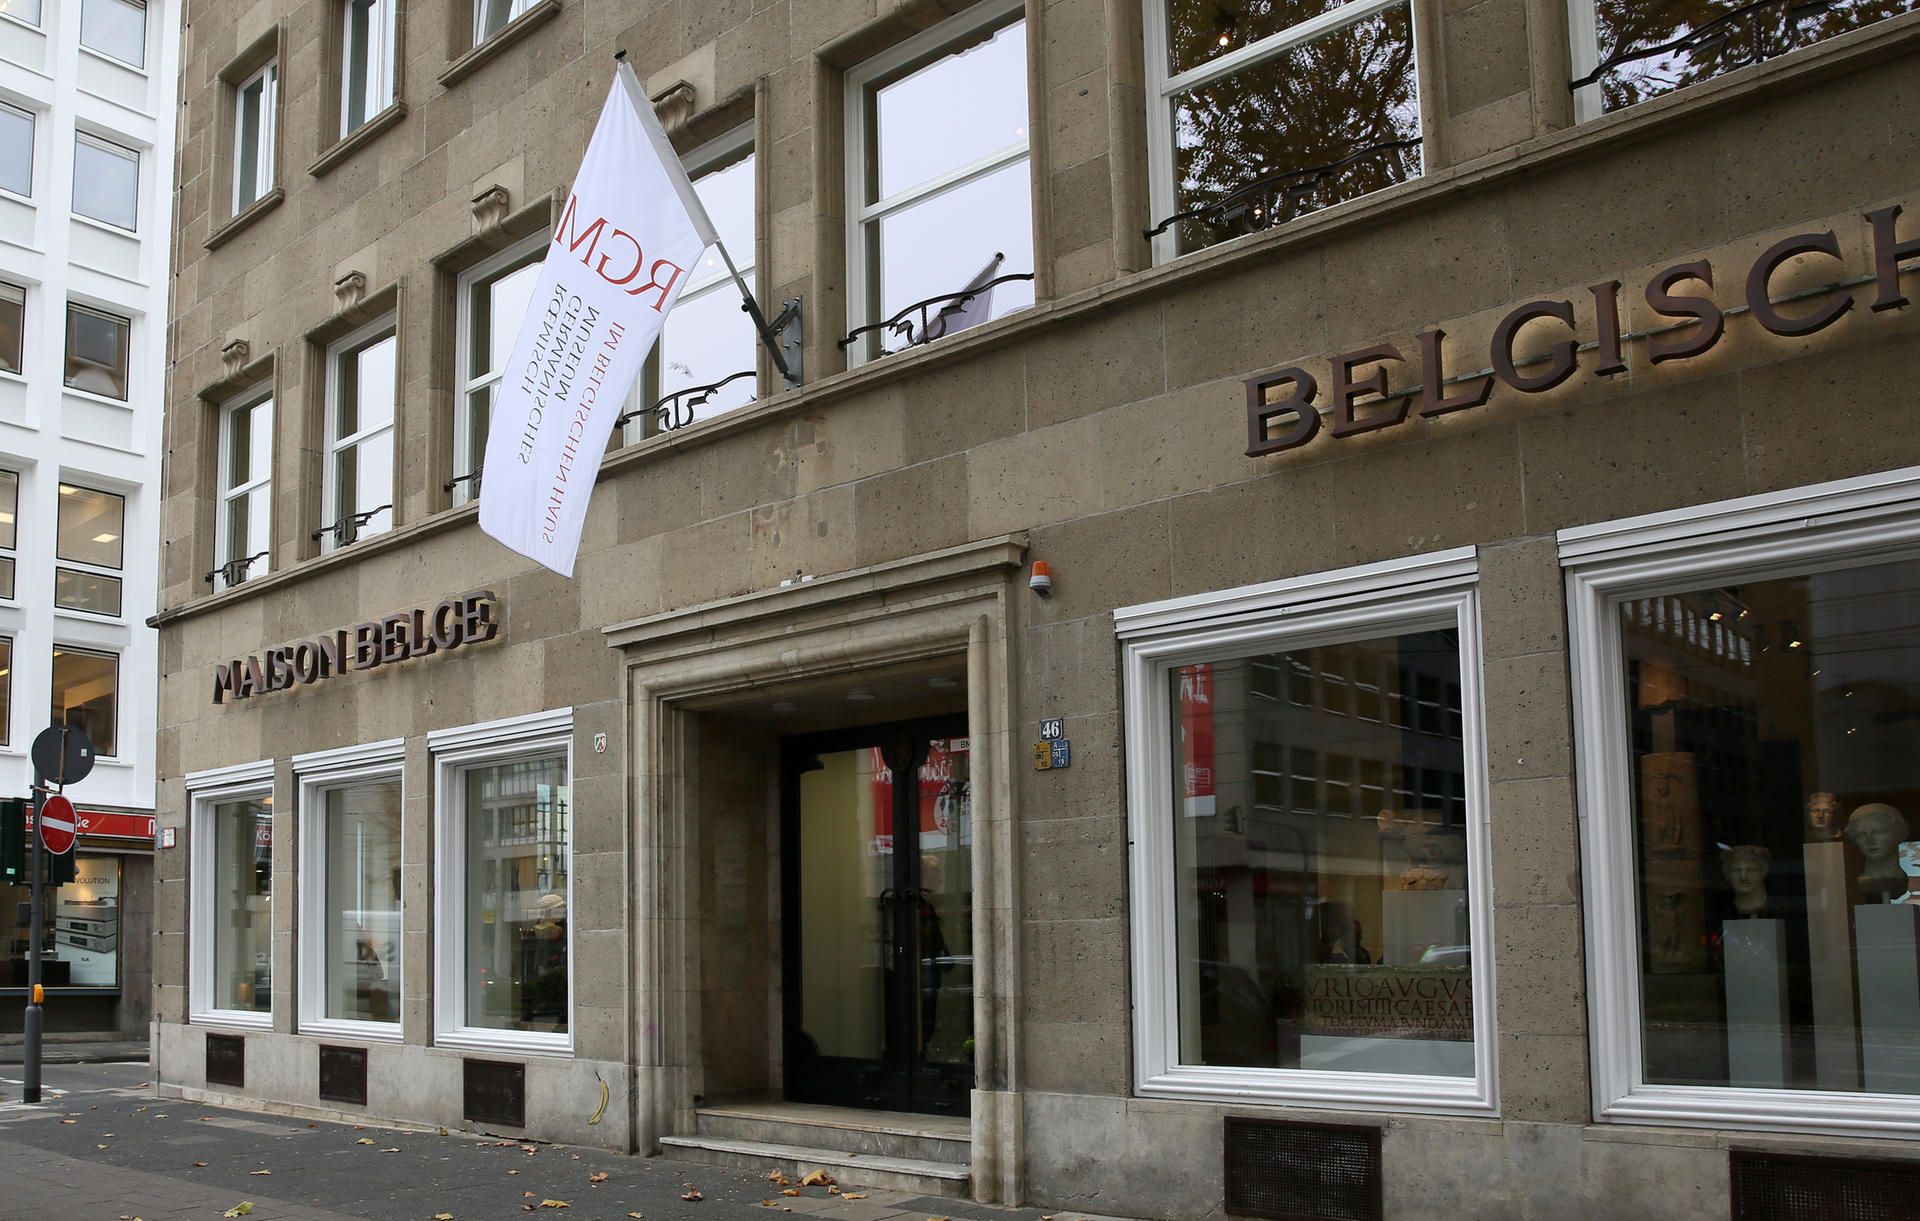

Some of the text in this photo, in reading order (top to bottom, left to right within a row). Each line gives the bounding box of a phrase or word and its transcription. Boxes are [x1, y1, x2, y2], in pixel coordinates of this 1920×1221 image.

[212, 590, 499, 704] MAISON BELGE
[1042, 721, 1060, 738] 46
[76, 877, 111, 885] VOLUTION
